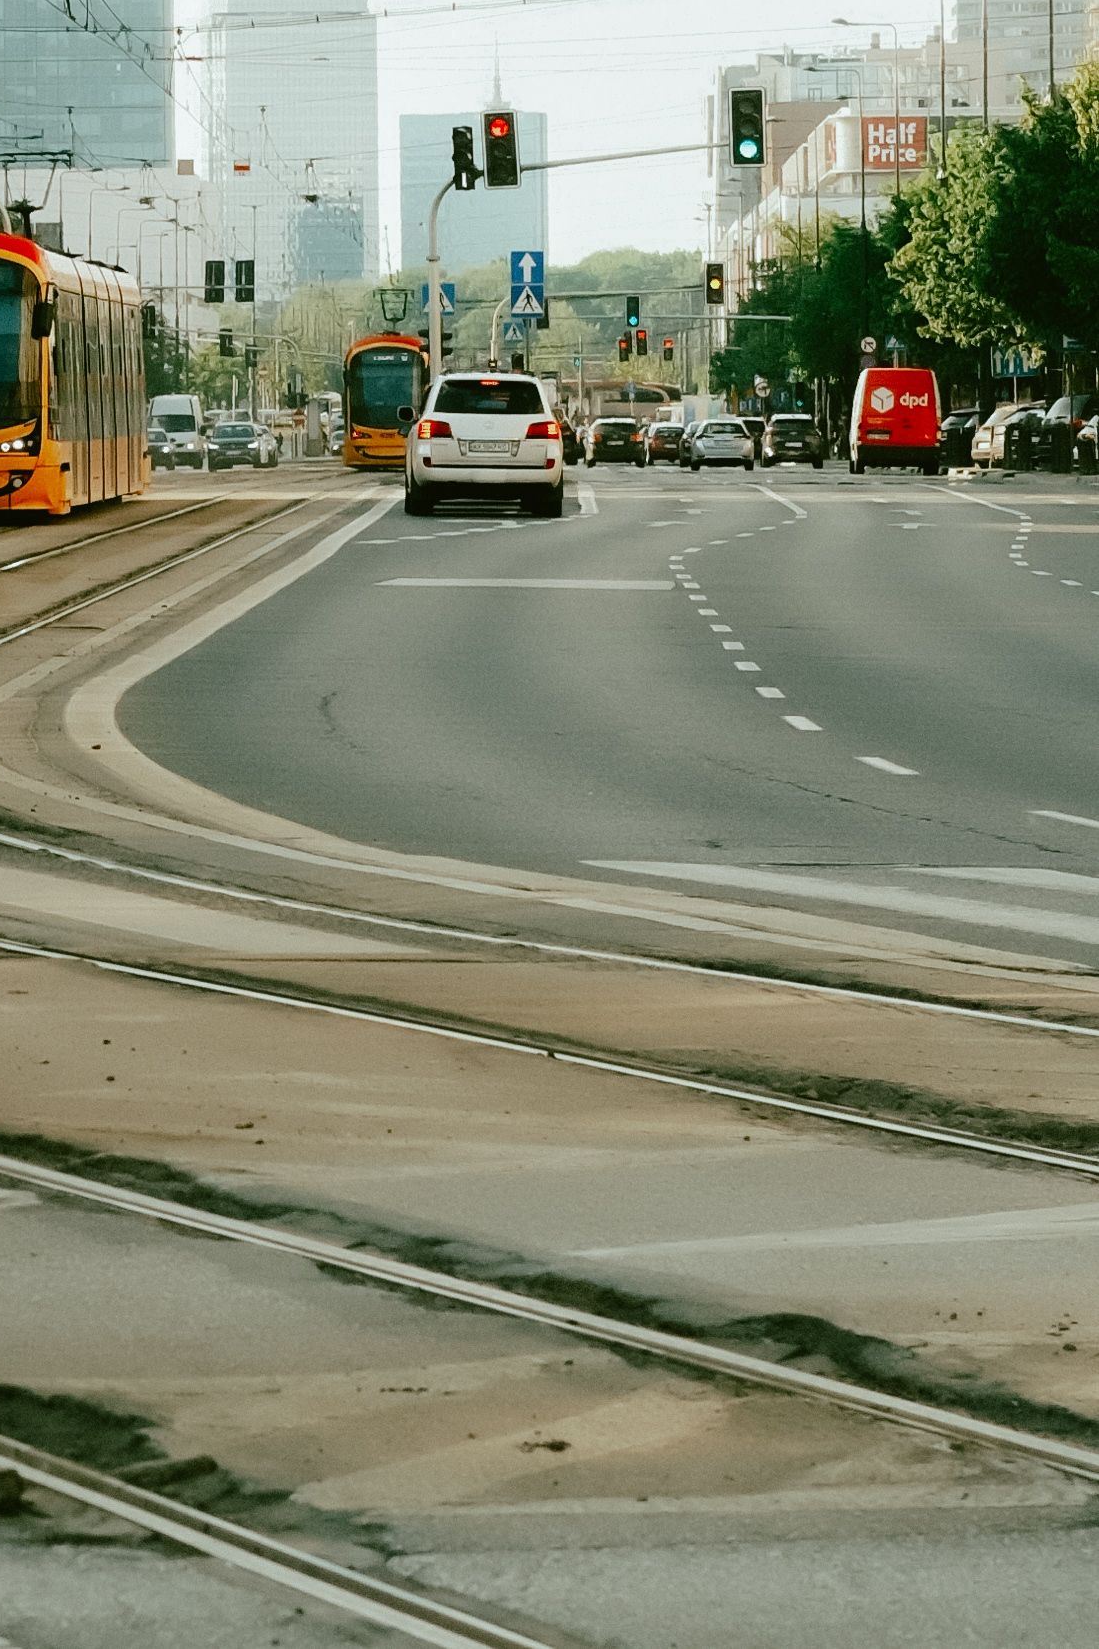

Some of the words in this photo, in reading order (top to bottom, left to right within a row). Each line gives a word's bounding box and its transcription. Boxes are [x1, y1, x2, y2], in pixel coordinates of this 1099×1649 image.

[867, 121, 917, 144] Half
[867, 144, 917, 163] Price
[899, 391, 929, 409] dpd
